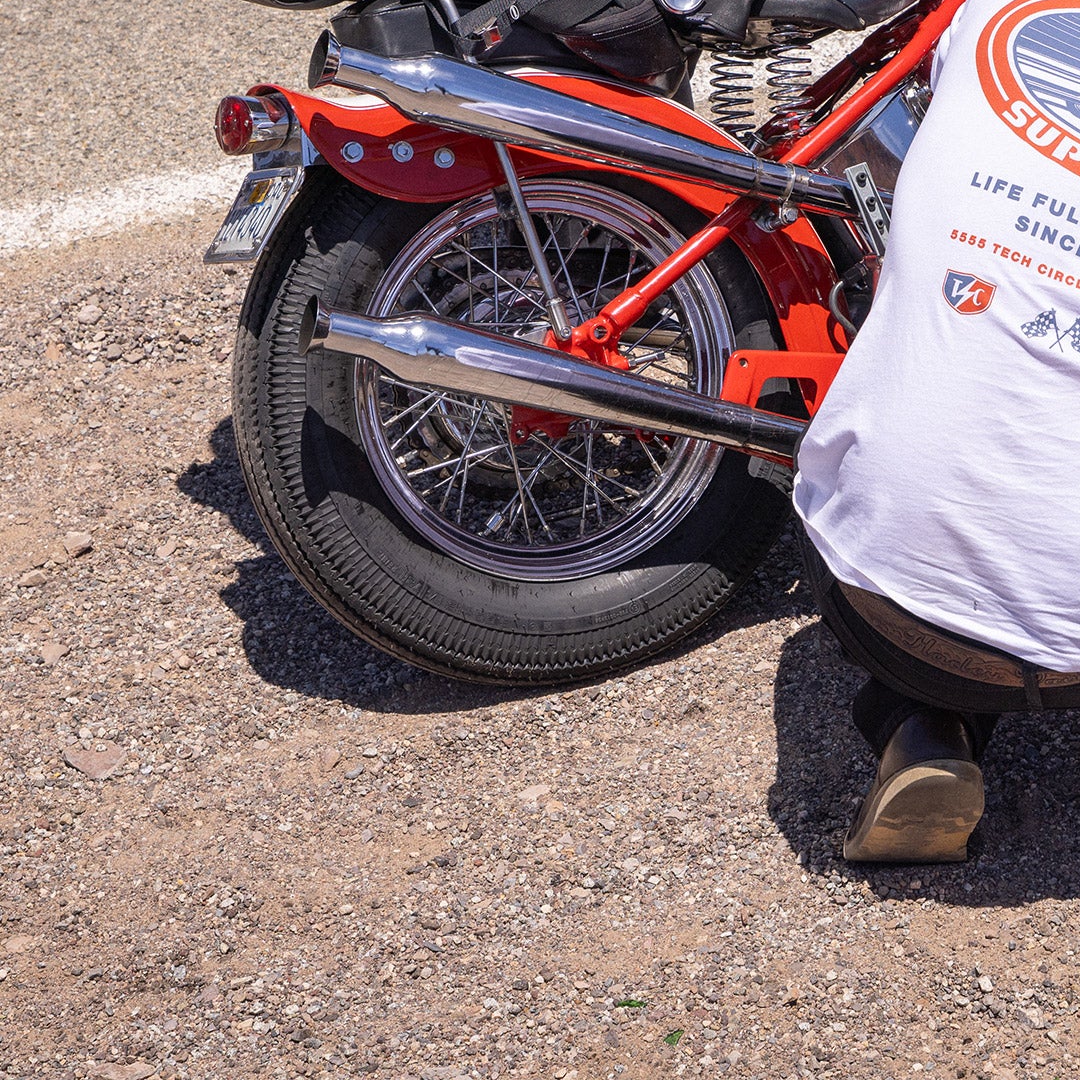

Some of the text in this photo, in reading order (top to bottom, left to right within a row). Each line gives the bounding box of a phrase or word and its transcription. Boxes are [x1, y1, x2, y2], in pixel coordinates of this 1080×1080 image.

[970, 172, 1024, 201] LIFE
[950, 229, 987, 249] 5555
[992, 243, 1032, 268] TECH
